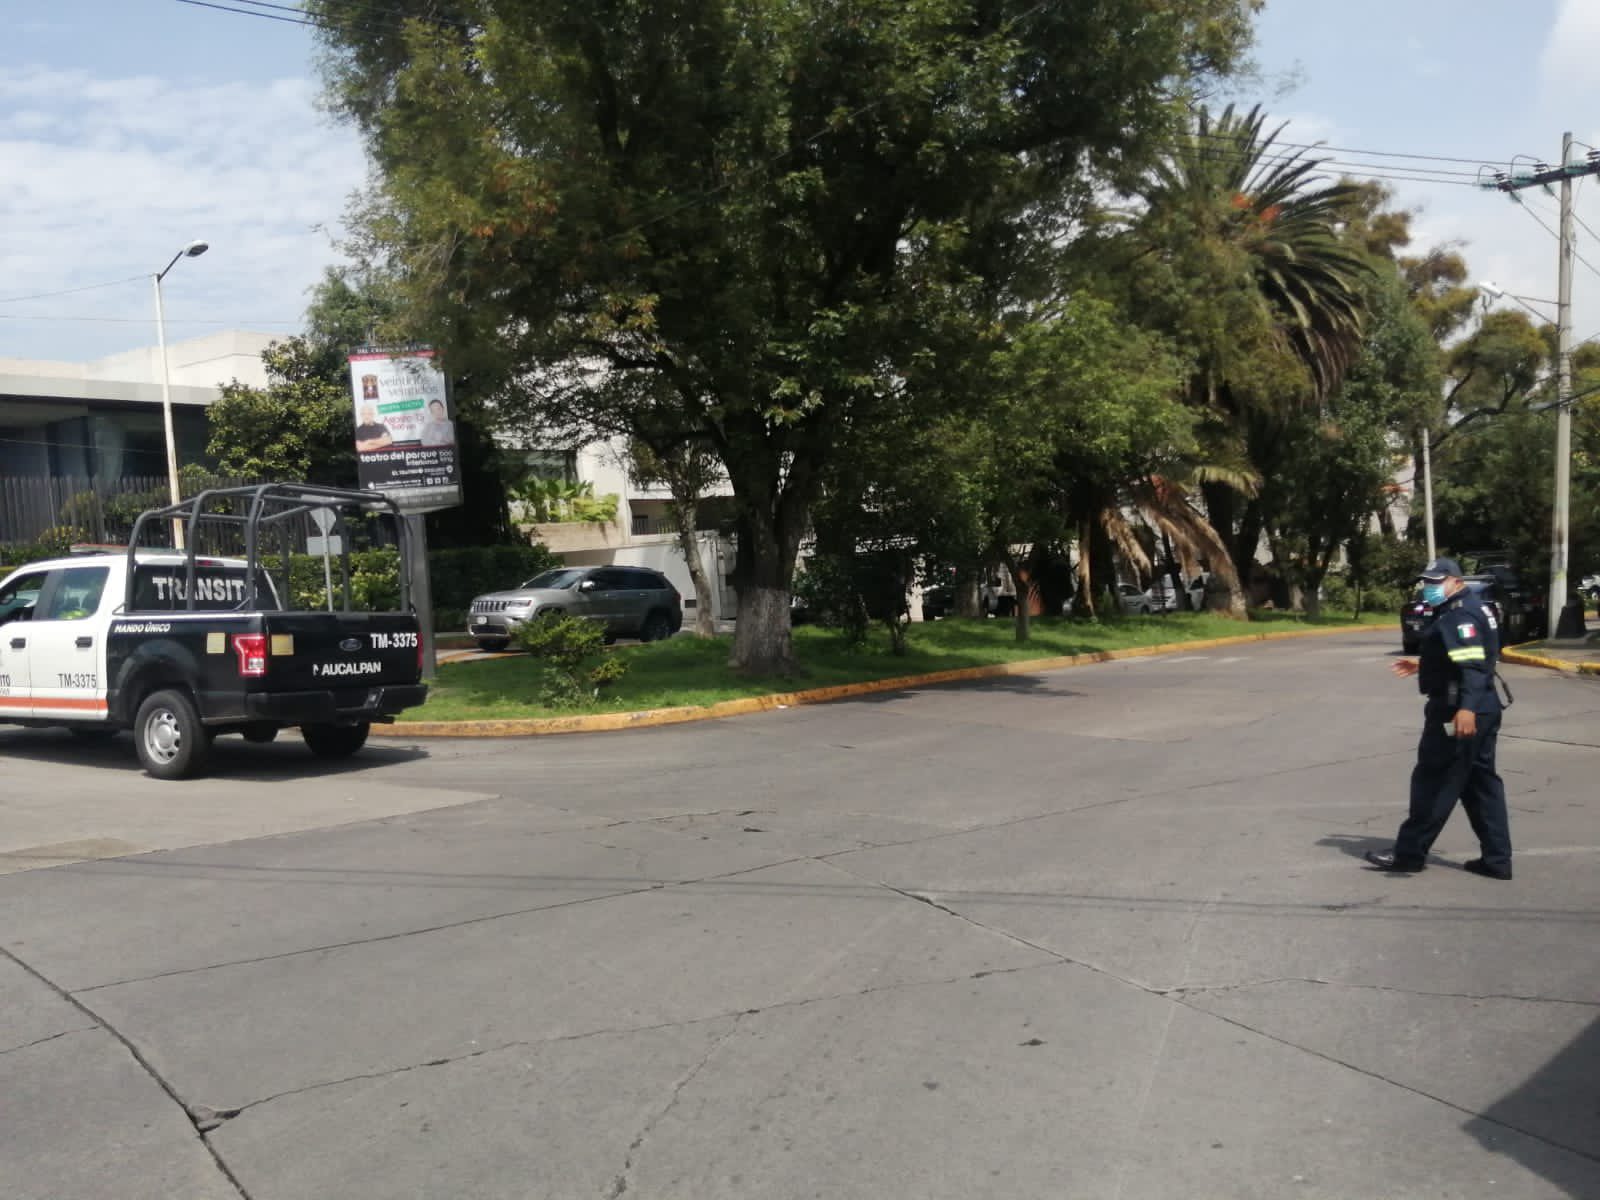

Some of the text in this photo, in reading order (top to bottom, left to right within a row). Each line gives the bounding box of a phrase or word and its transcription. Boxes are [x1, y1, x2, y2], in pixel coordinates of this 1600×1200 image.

[390, 451, 405, 460] del
[151, 575, 258, 601] TRANSIT
[370, 632, 418, 649] TM-3375
[58, 673, 97, 689] TM-3375
